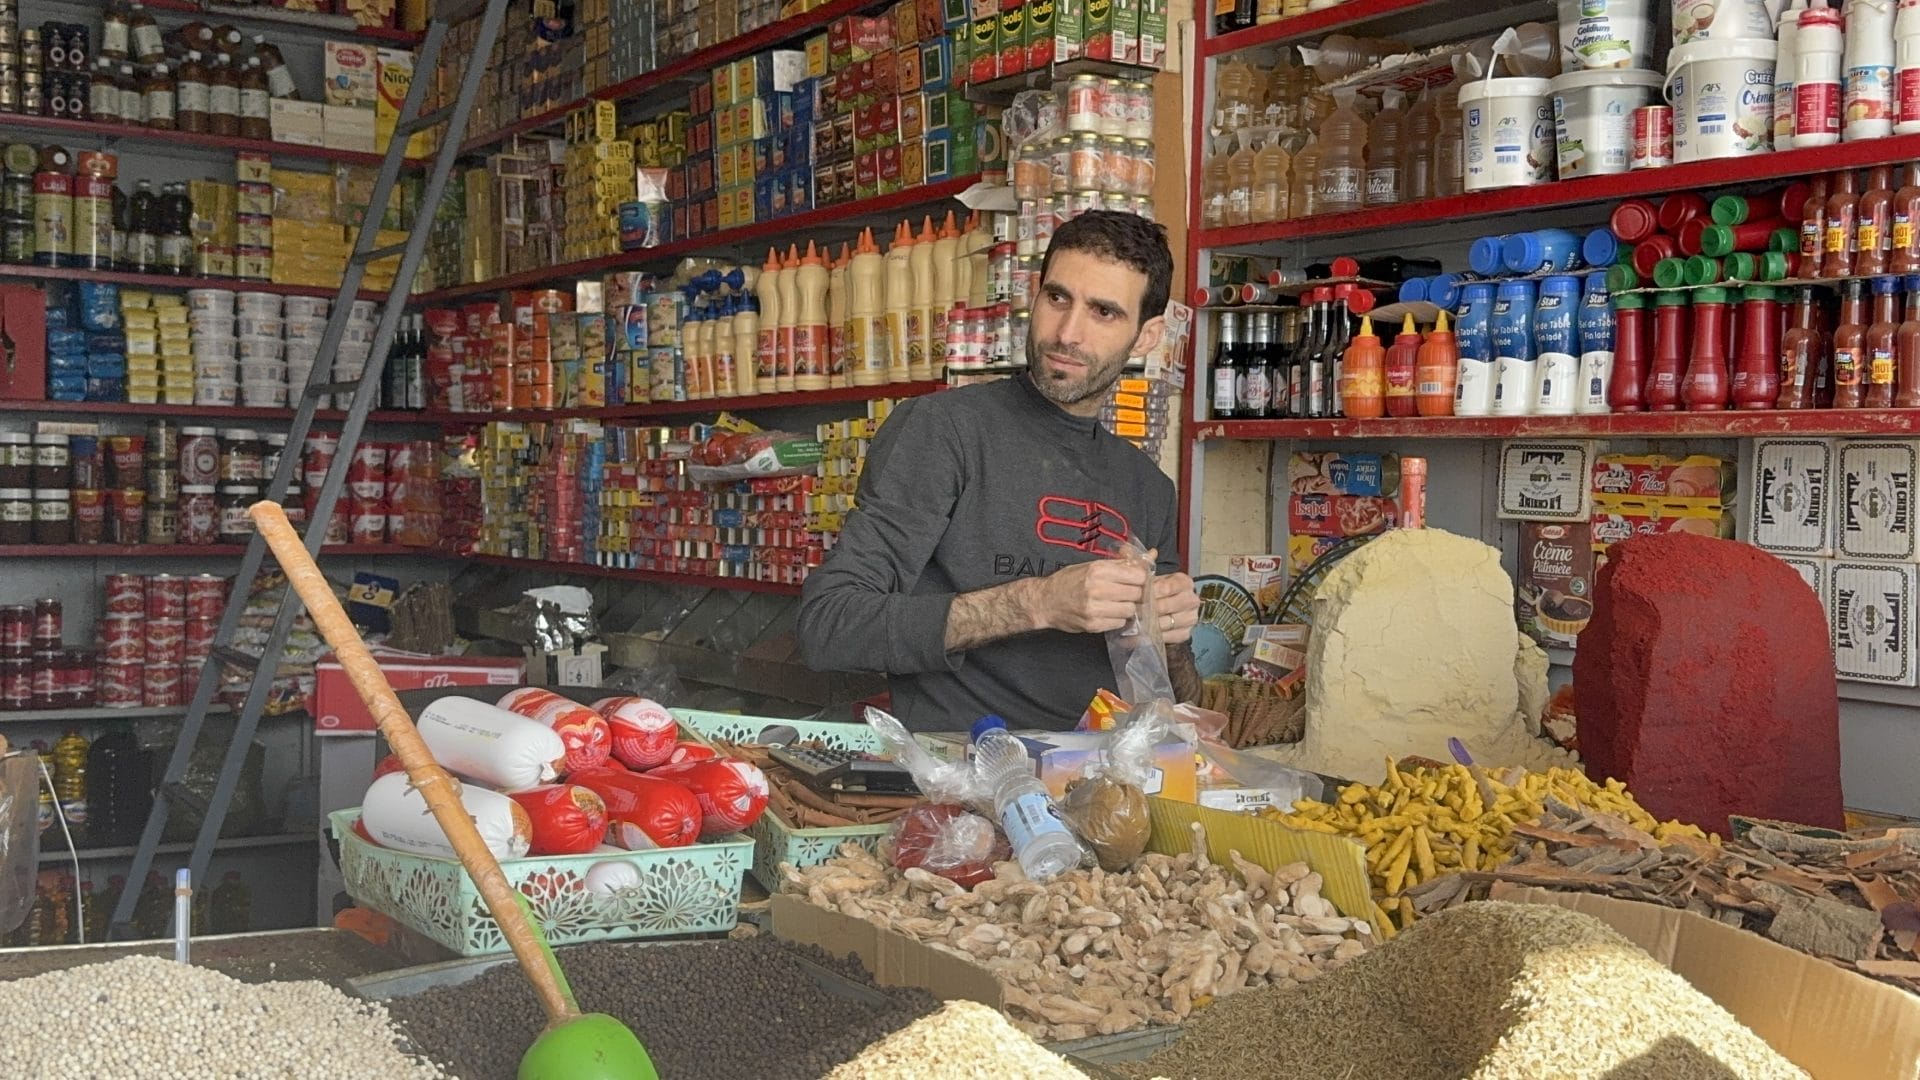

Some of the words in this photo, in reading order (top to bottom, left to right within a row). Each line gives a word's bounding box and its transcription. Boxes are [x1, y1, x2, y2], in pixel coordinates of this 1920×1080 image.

[1032, 2, 1053, 18] solis
[1003, 12, 1023, 26] solis
[975, 19, 996, 34] solis
[1541, 296, 1560, 306] Star
[1589, 294, 1607, 303] Star
[1550, 318, 1571, 329] Table
[1460, 328, 1478, 336] Table
[1357, 474, 1376, 487] Thon
[1638, 473, 1666, 492] Thon
[1295, 501, 1331, 518] Isabel
[1533, 541, 1573, 561] Crème
[1533, 560, 1571, 575] Pâtissière
